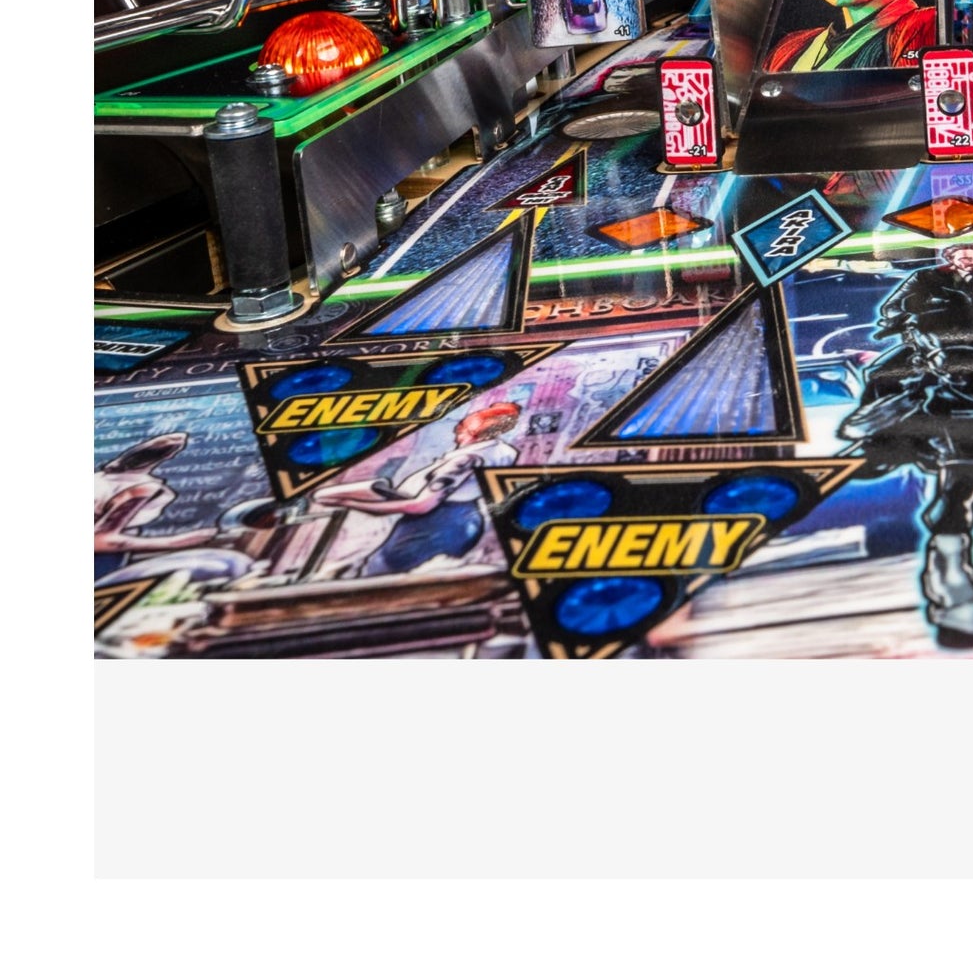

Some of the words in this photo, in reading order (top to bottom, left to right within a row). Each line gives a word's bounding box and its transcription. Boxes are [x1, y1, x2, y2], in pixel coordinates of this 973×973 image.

[614, 25, 630, 36] -11
[950, 134, 971, 146] -22
[688, 144, 707, 157] -21
[763, 209, 816, 257] AKIRA
[186, 360, 240, 375] OF
[270, 388, 459, 428] ENEMY
[528, 520, 750, 570] ENEMY
